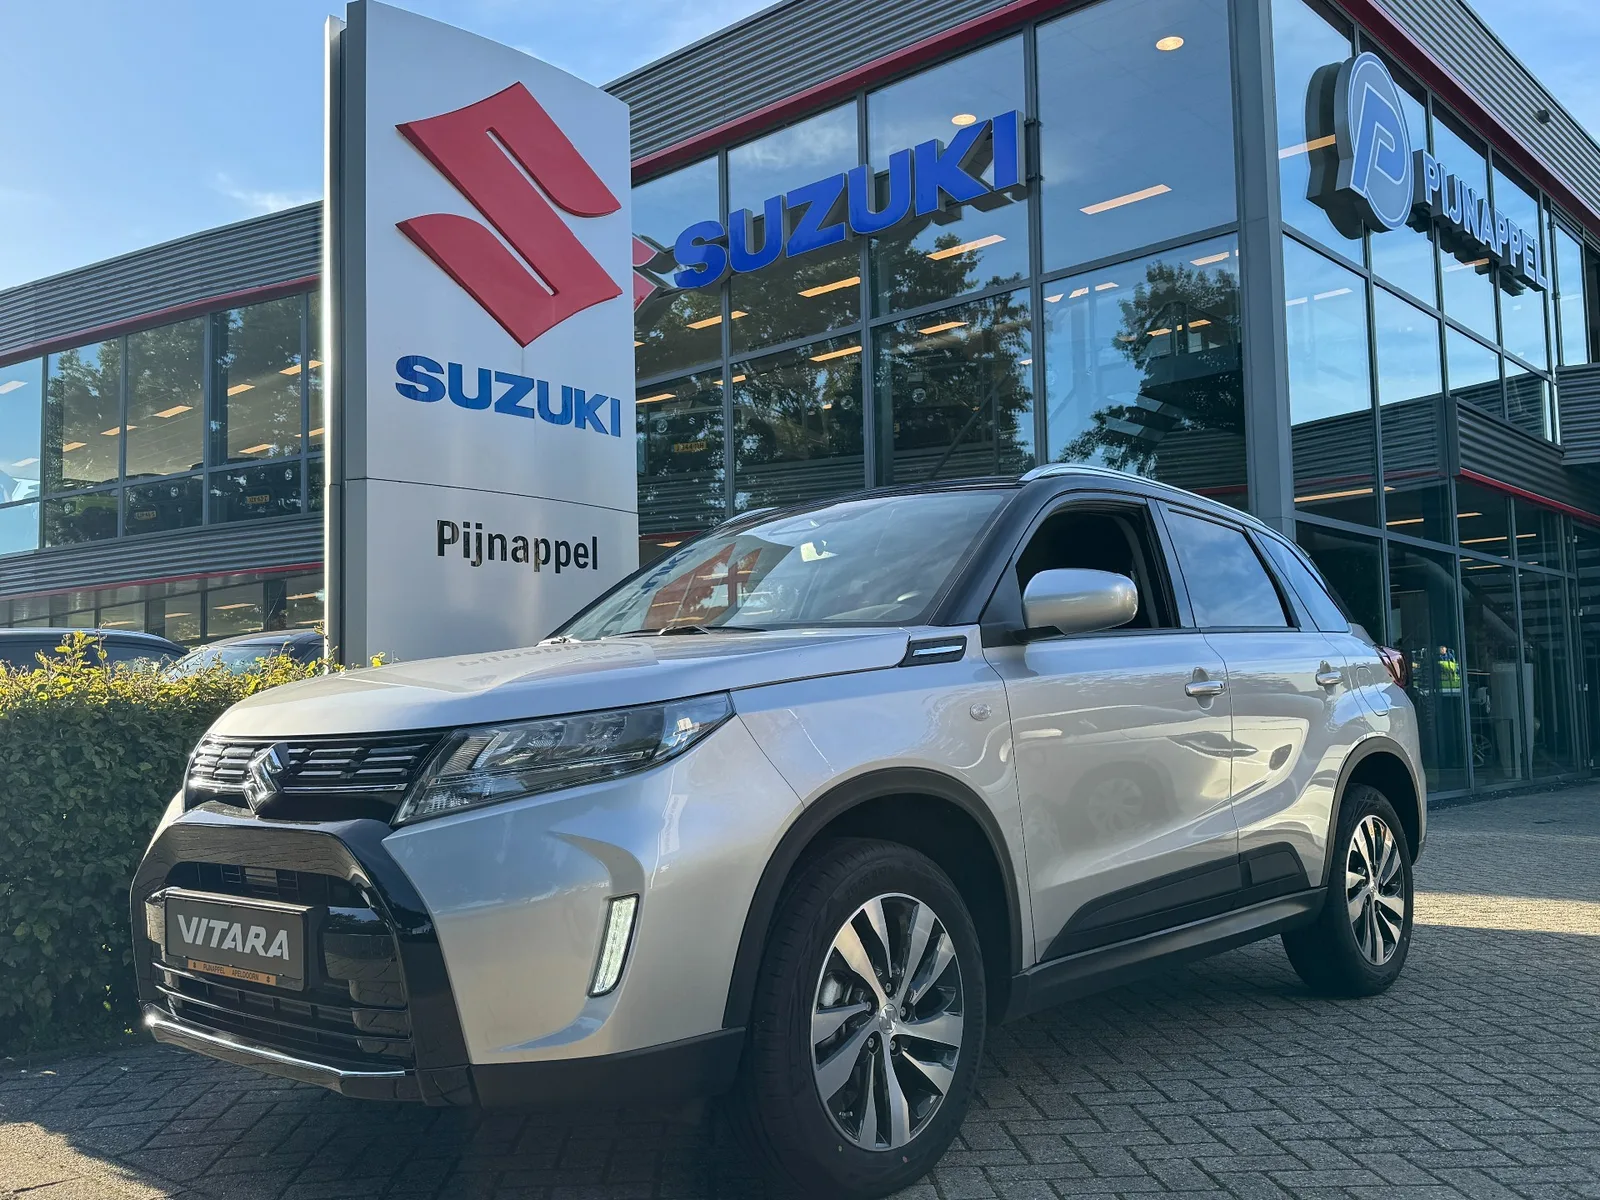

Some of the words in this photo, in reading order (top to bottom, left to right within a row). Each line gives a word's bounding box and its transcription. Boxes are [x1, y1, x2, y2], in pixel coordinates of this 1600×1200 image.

[673, 109, 1021, 290] SUZUKI
[1421, 148, 1548, 291] PIJNAPPEL
[395, 354, 622, 438] SUZUKI
[436, 519, 599, 574] Pijnappel
[177, 914, 290, 961] VITARA
[231, 969, 260, 981] APELDOORN
